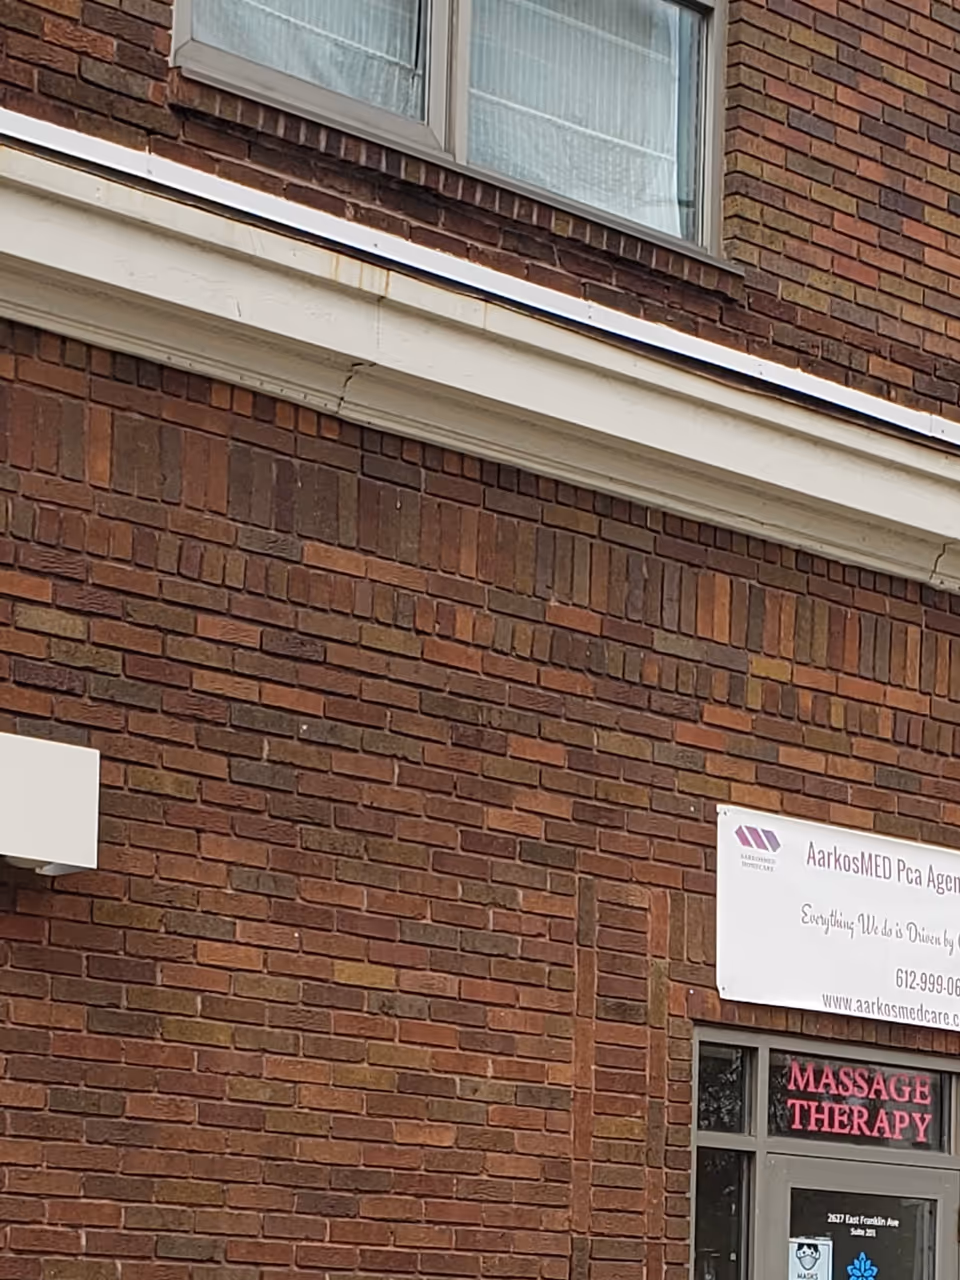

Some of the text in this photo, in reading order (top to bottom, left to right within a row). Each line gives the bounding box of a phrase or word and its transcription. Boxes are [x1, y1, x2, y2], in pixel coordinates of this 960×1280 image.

[806, 841, 892, 880] AarkosMED
[897, 859, 922, 886] Pca
[801, 903, 855, 940] Everything
[857, 913, 879, 935] We
[881, 918, 892, 938] do
[895, 922, 903, 939] is
[906, 921, 941, 946] Driven
[943, 928, 954, 956] by
[787, 1059, 932, 1105] MASSAGE
[786, 1098, 933, 1142] THERAPY
[797, 1272, 819, 1280] MASKS
